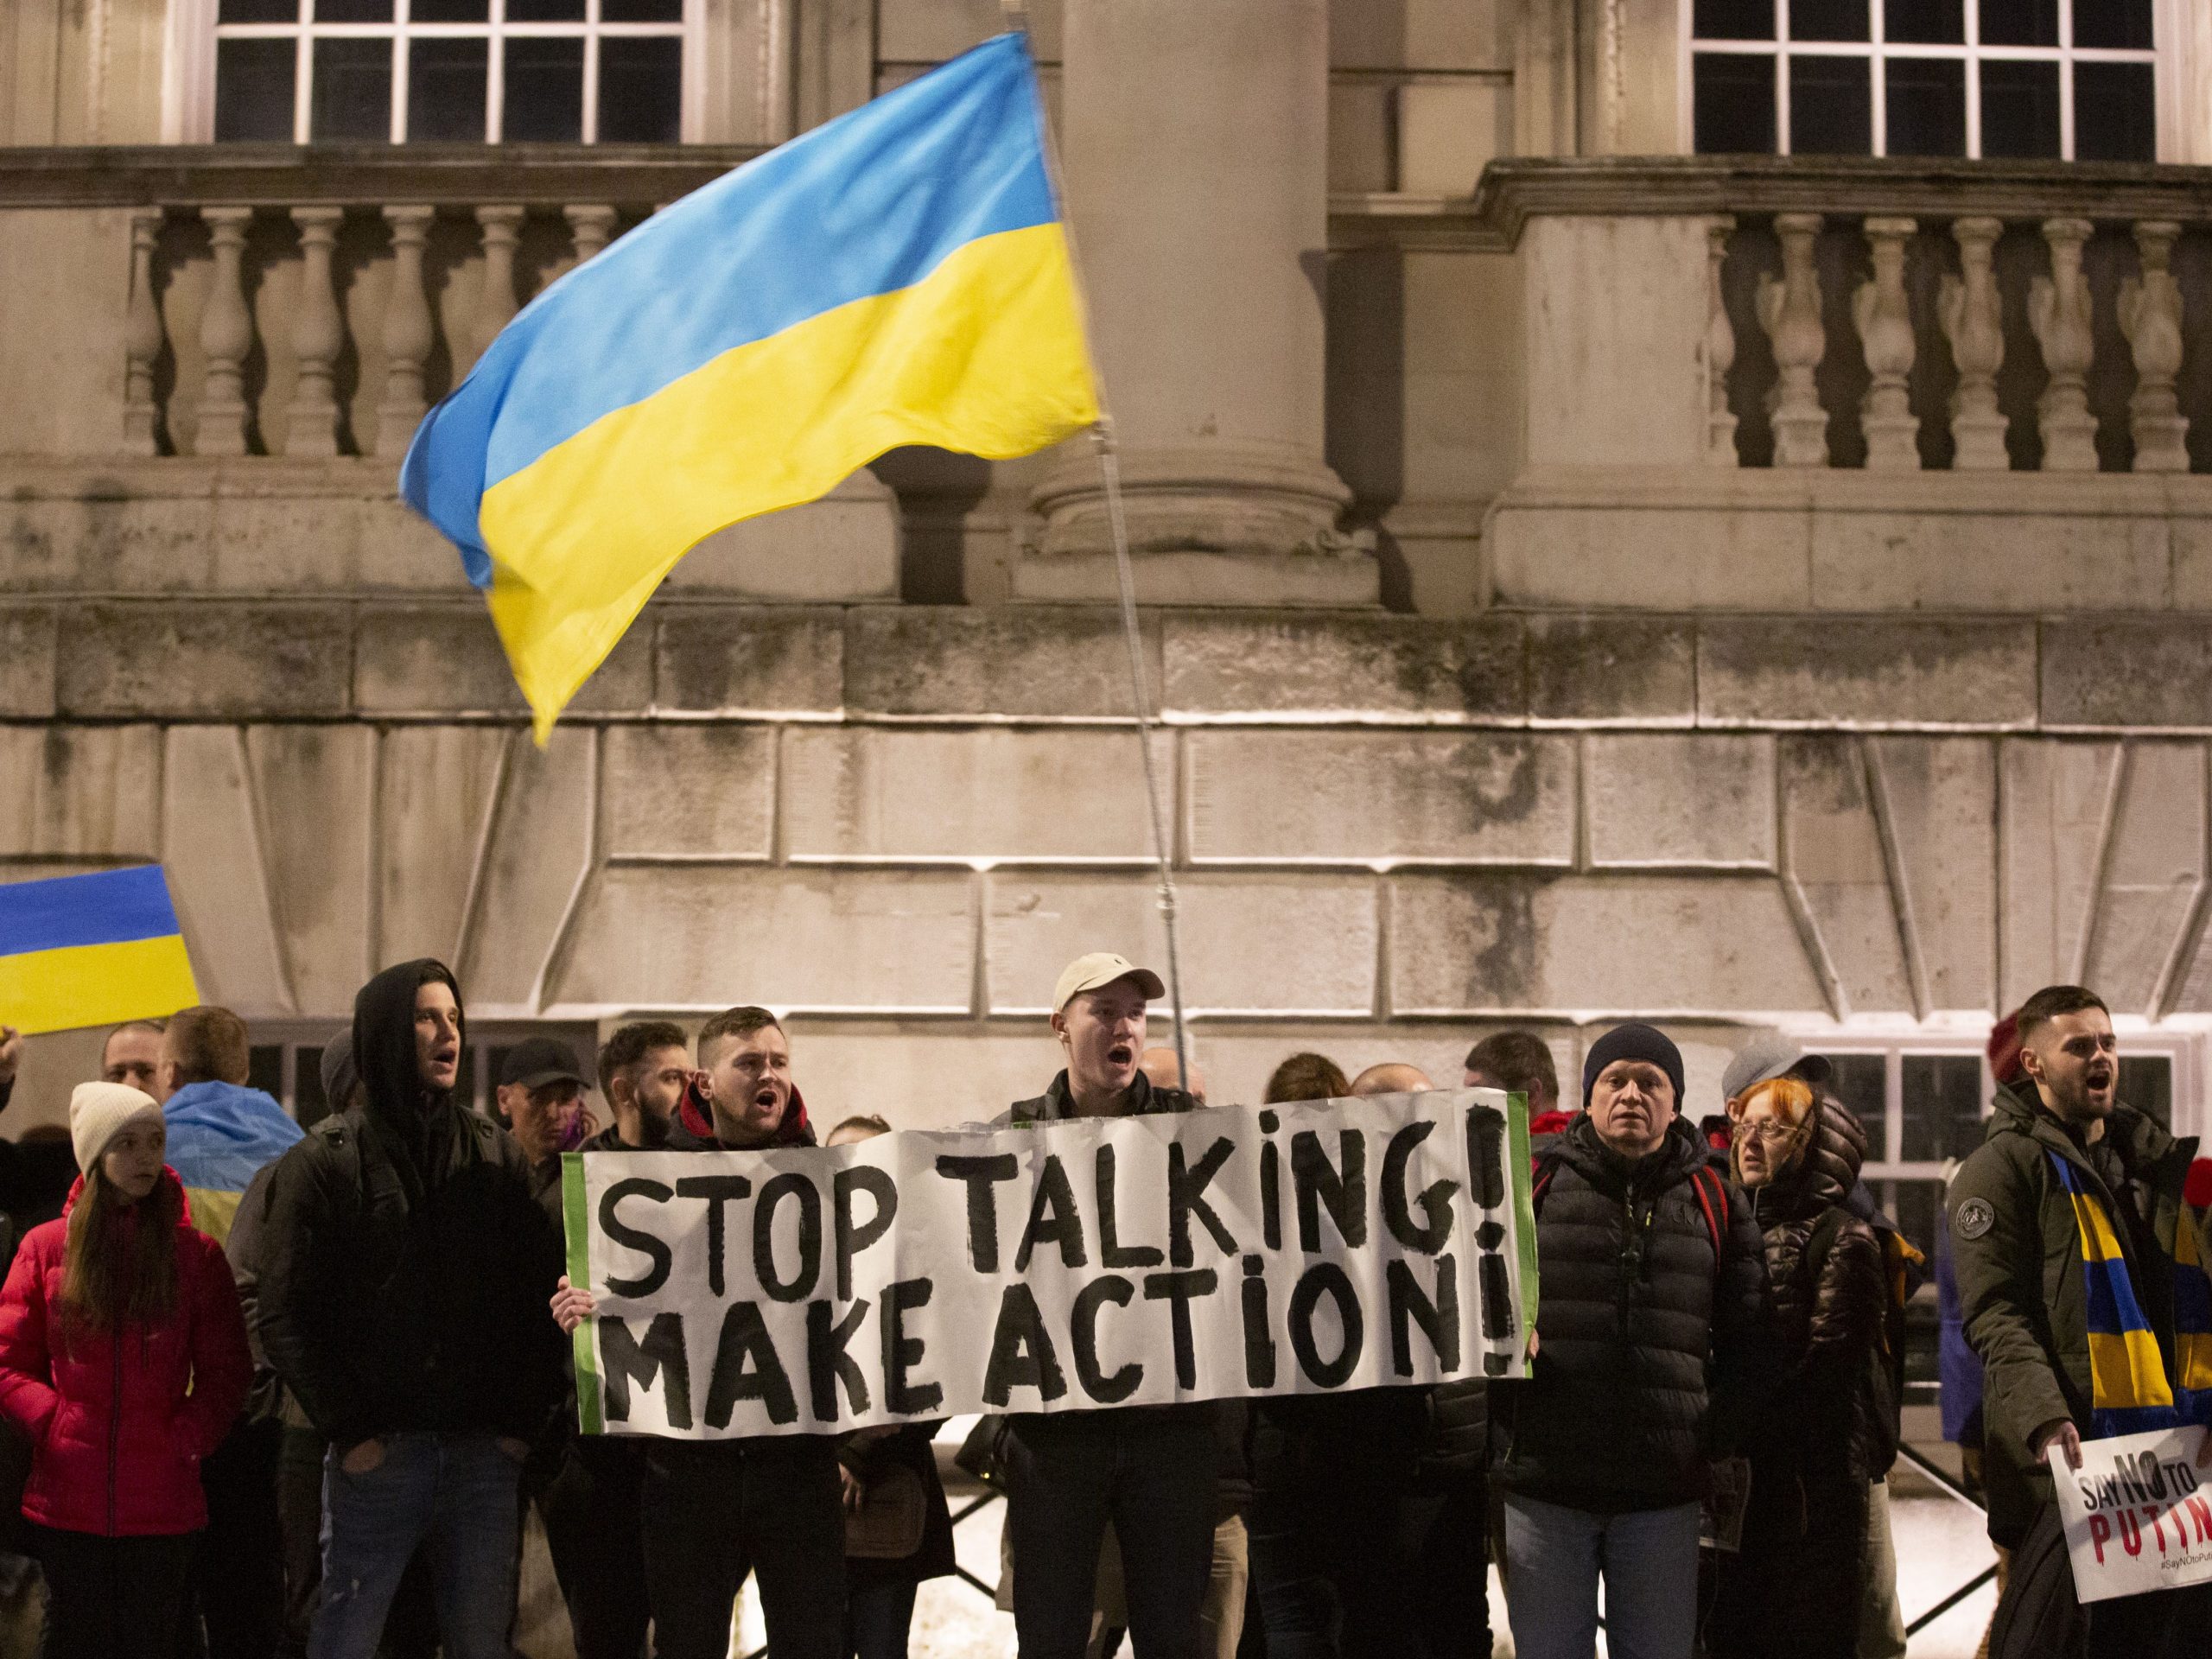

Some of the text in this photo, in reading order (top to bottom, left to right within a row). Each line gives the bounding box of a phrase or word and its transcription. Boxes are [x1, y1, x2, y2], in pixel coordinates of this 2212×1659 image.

[598, 1166, 898, 1303] STOP
[598, 1277, 944, 1431] MAKE
[2078, 1450, 2199, 1511] SAY NO TO
[2088, 1497, 2212, 1566] PUTIN
